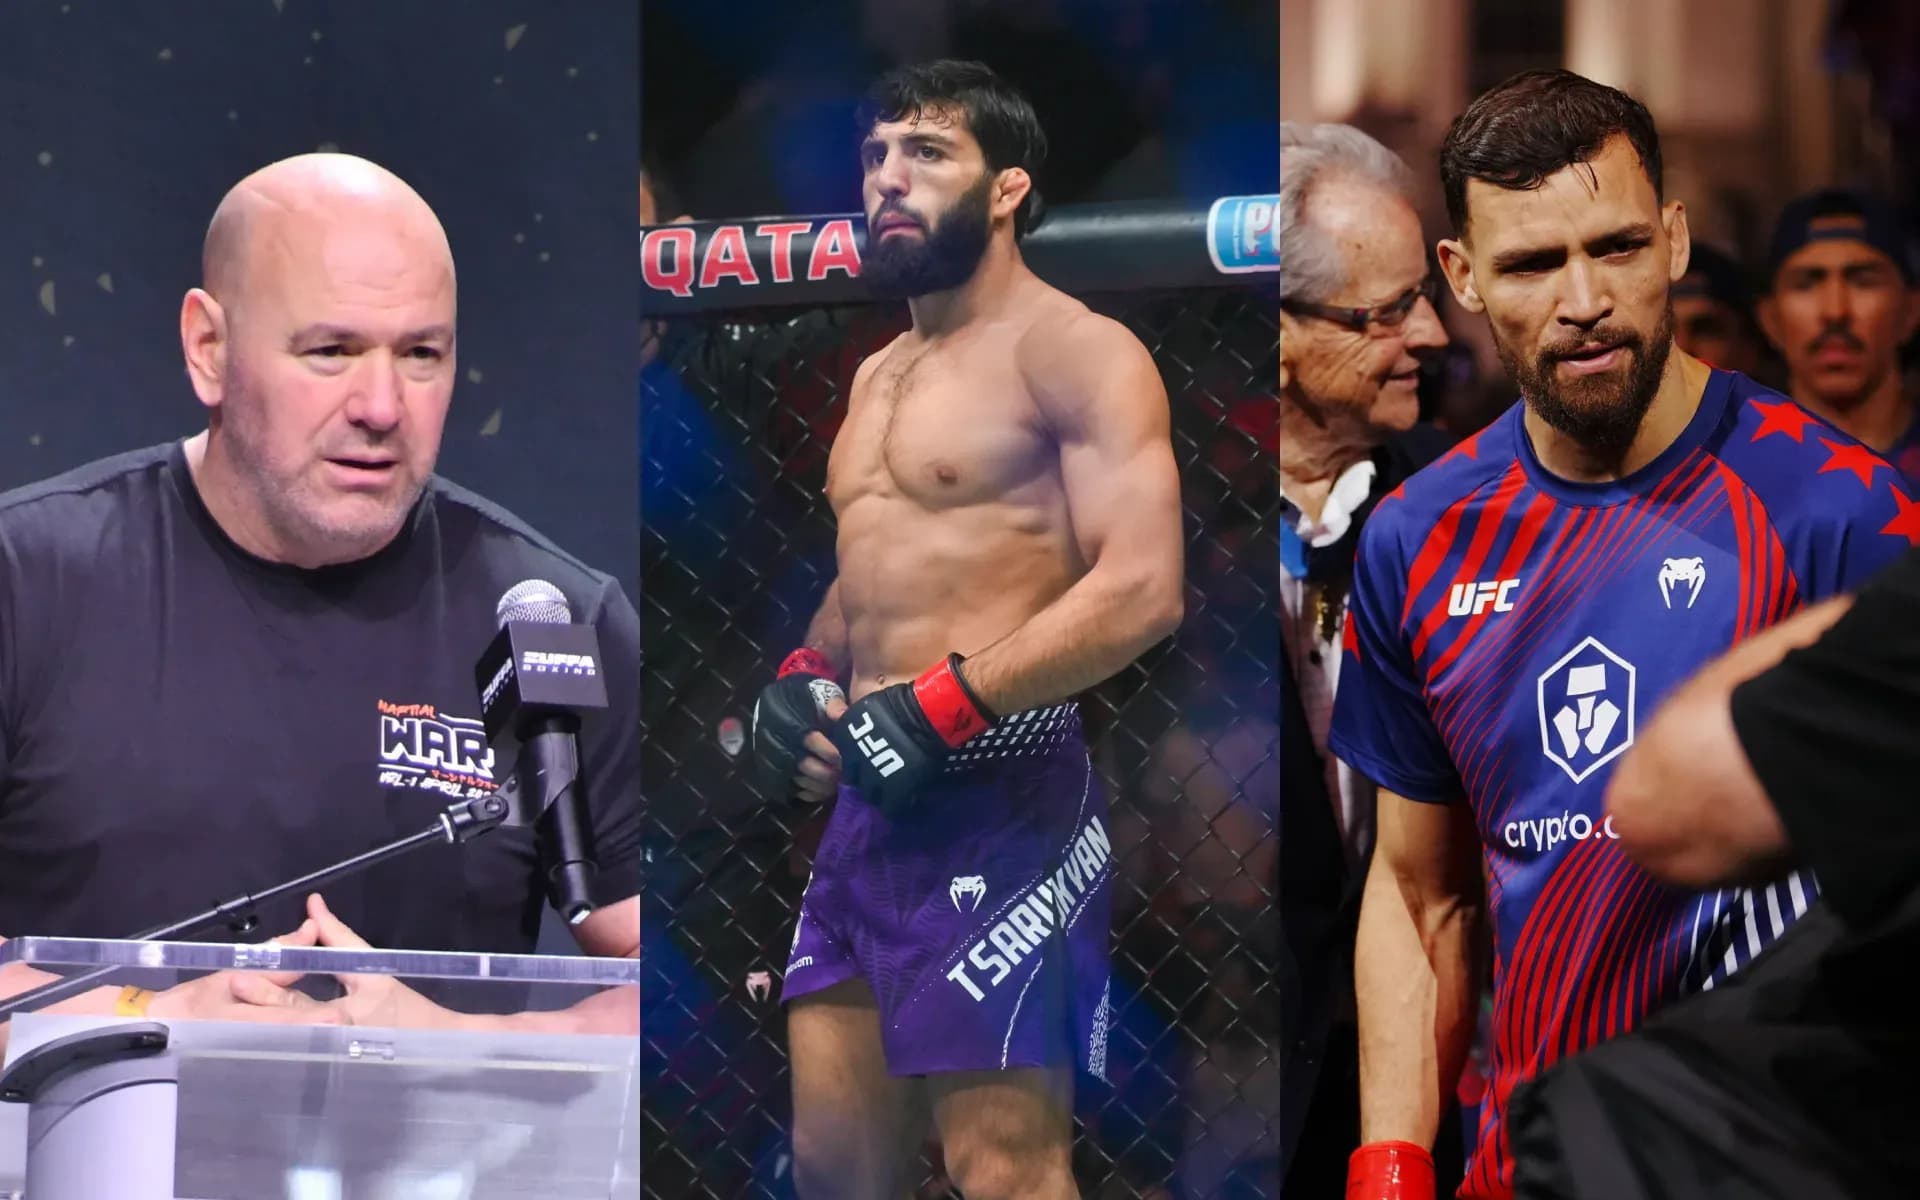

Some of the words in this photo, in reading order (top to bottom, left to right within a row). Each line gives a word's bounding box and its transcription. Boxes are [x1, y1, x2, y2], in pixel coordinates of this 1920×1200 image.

[641, 219, 863, 298] QATA
[1447, 578, 1521, 617] UFC
[521, 664, 597, 676] BOXING
[522, 650, 596, 669] ZUFFA
[377, 698, 437, 720] MARTIAL
[380, 713, 495, 779] WAR
[847, 711, 905, 778] UFC
[420, 777, 465, 798] APRIL
[1504, 809, 1622, 852] crypto.c
[946, 815, 1112, 1003] TSARUKYAN
